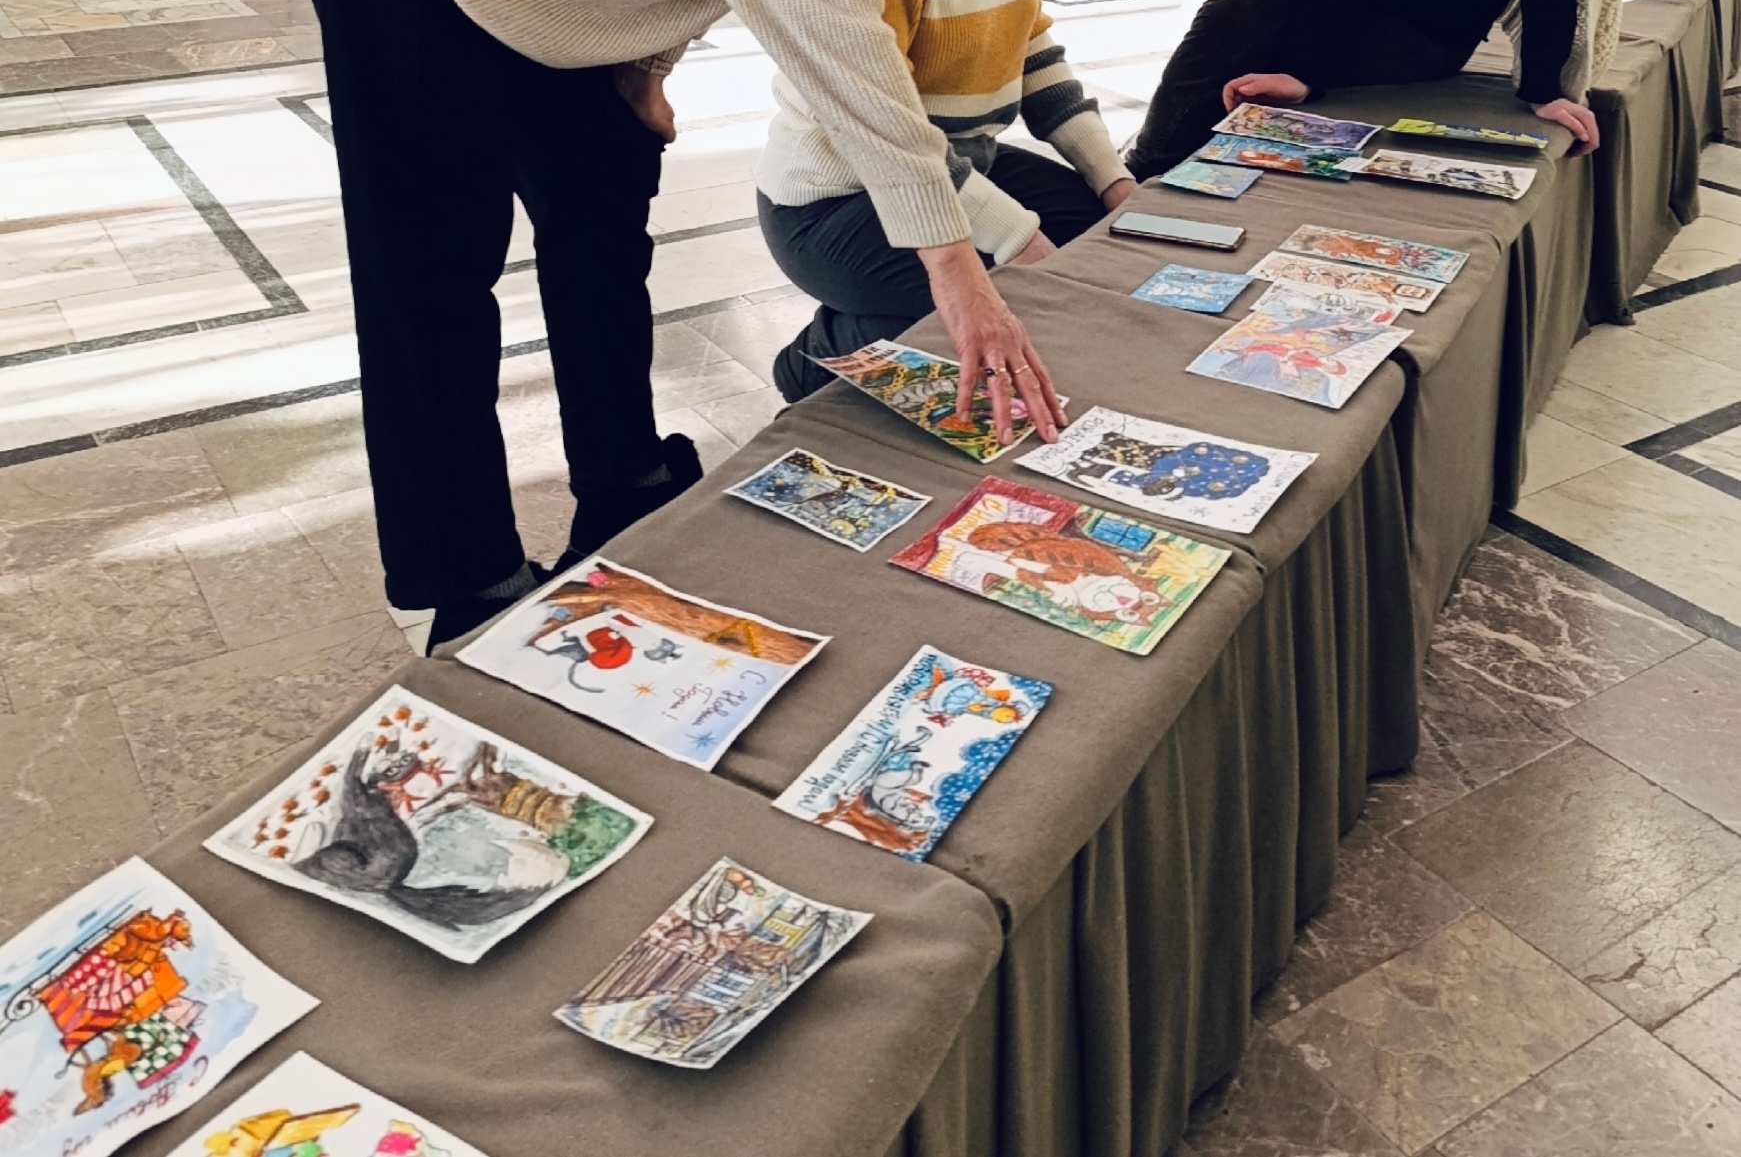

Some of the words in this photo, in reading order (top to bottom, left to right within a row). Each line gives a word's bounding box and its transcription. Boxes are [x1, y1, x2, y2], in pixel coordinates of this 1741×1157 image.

[739, 670, 767, 685] С
[691, 689, 748, 726] Новым
[190, 1055, 209, 1087] С
